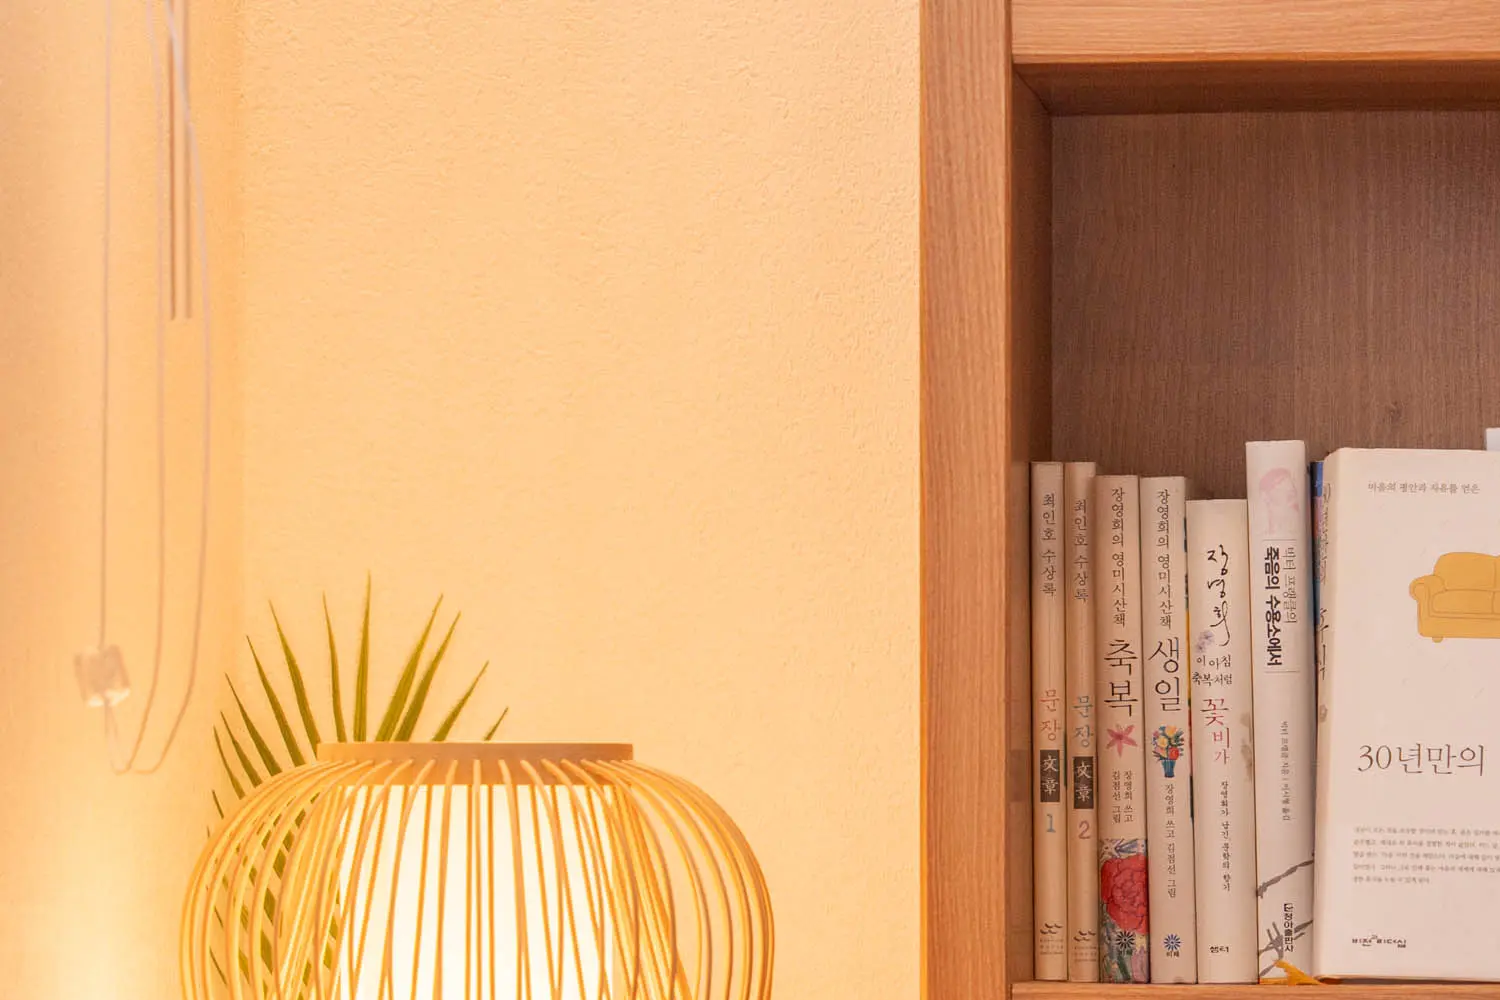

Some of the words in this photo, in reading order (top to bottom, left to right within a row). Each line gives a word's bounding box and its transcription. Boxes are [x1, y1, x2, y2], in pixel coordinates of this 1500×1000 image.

[1042, 492, 1057, 541] 최인호
[1074, 499, 1088, 546] 최인호
[1042, 551, 1057, 597] 수상록
[1074, 555, 1089, 602] 수상록
[1264, 546, 1281, 591] 죽음의
[1266, 595, 1283, 667] 수용소에서
[1104, 639, 1138, 717] 축복
[1148, 637, 1181, 712] 생일
[1040, 690, 1060, 743] 문장
[1073, 696, 1093, 748] 문장
[1357, 742, 1486, 777] 30년만의
[1046, 813, 1057, 833] 1
[1078, 820, 1090, 839] 2
